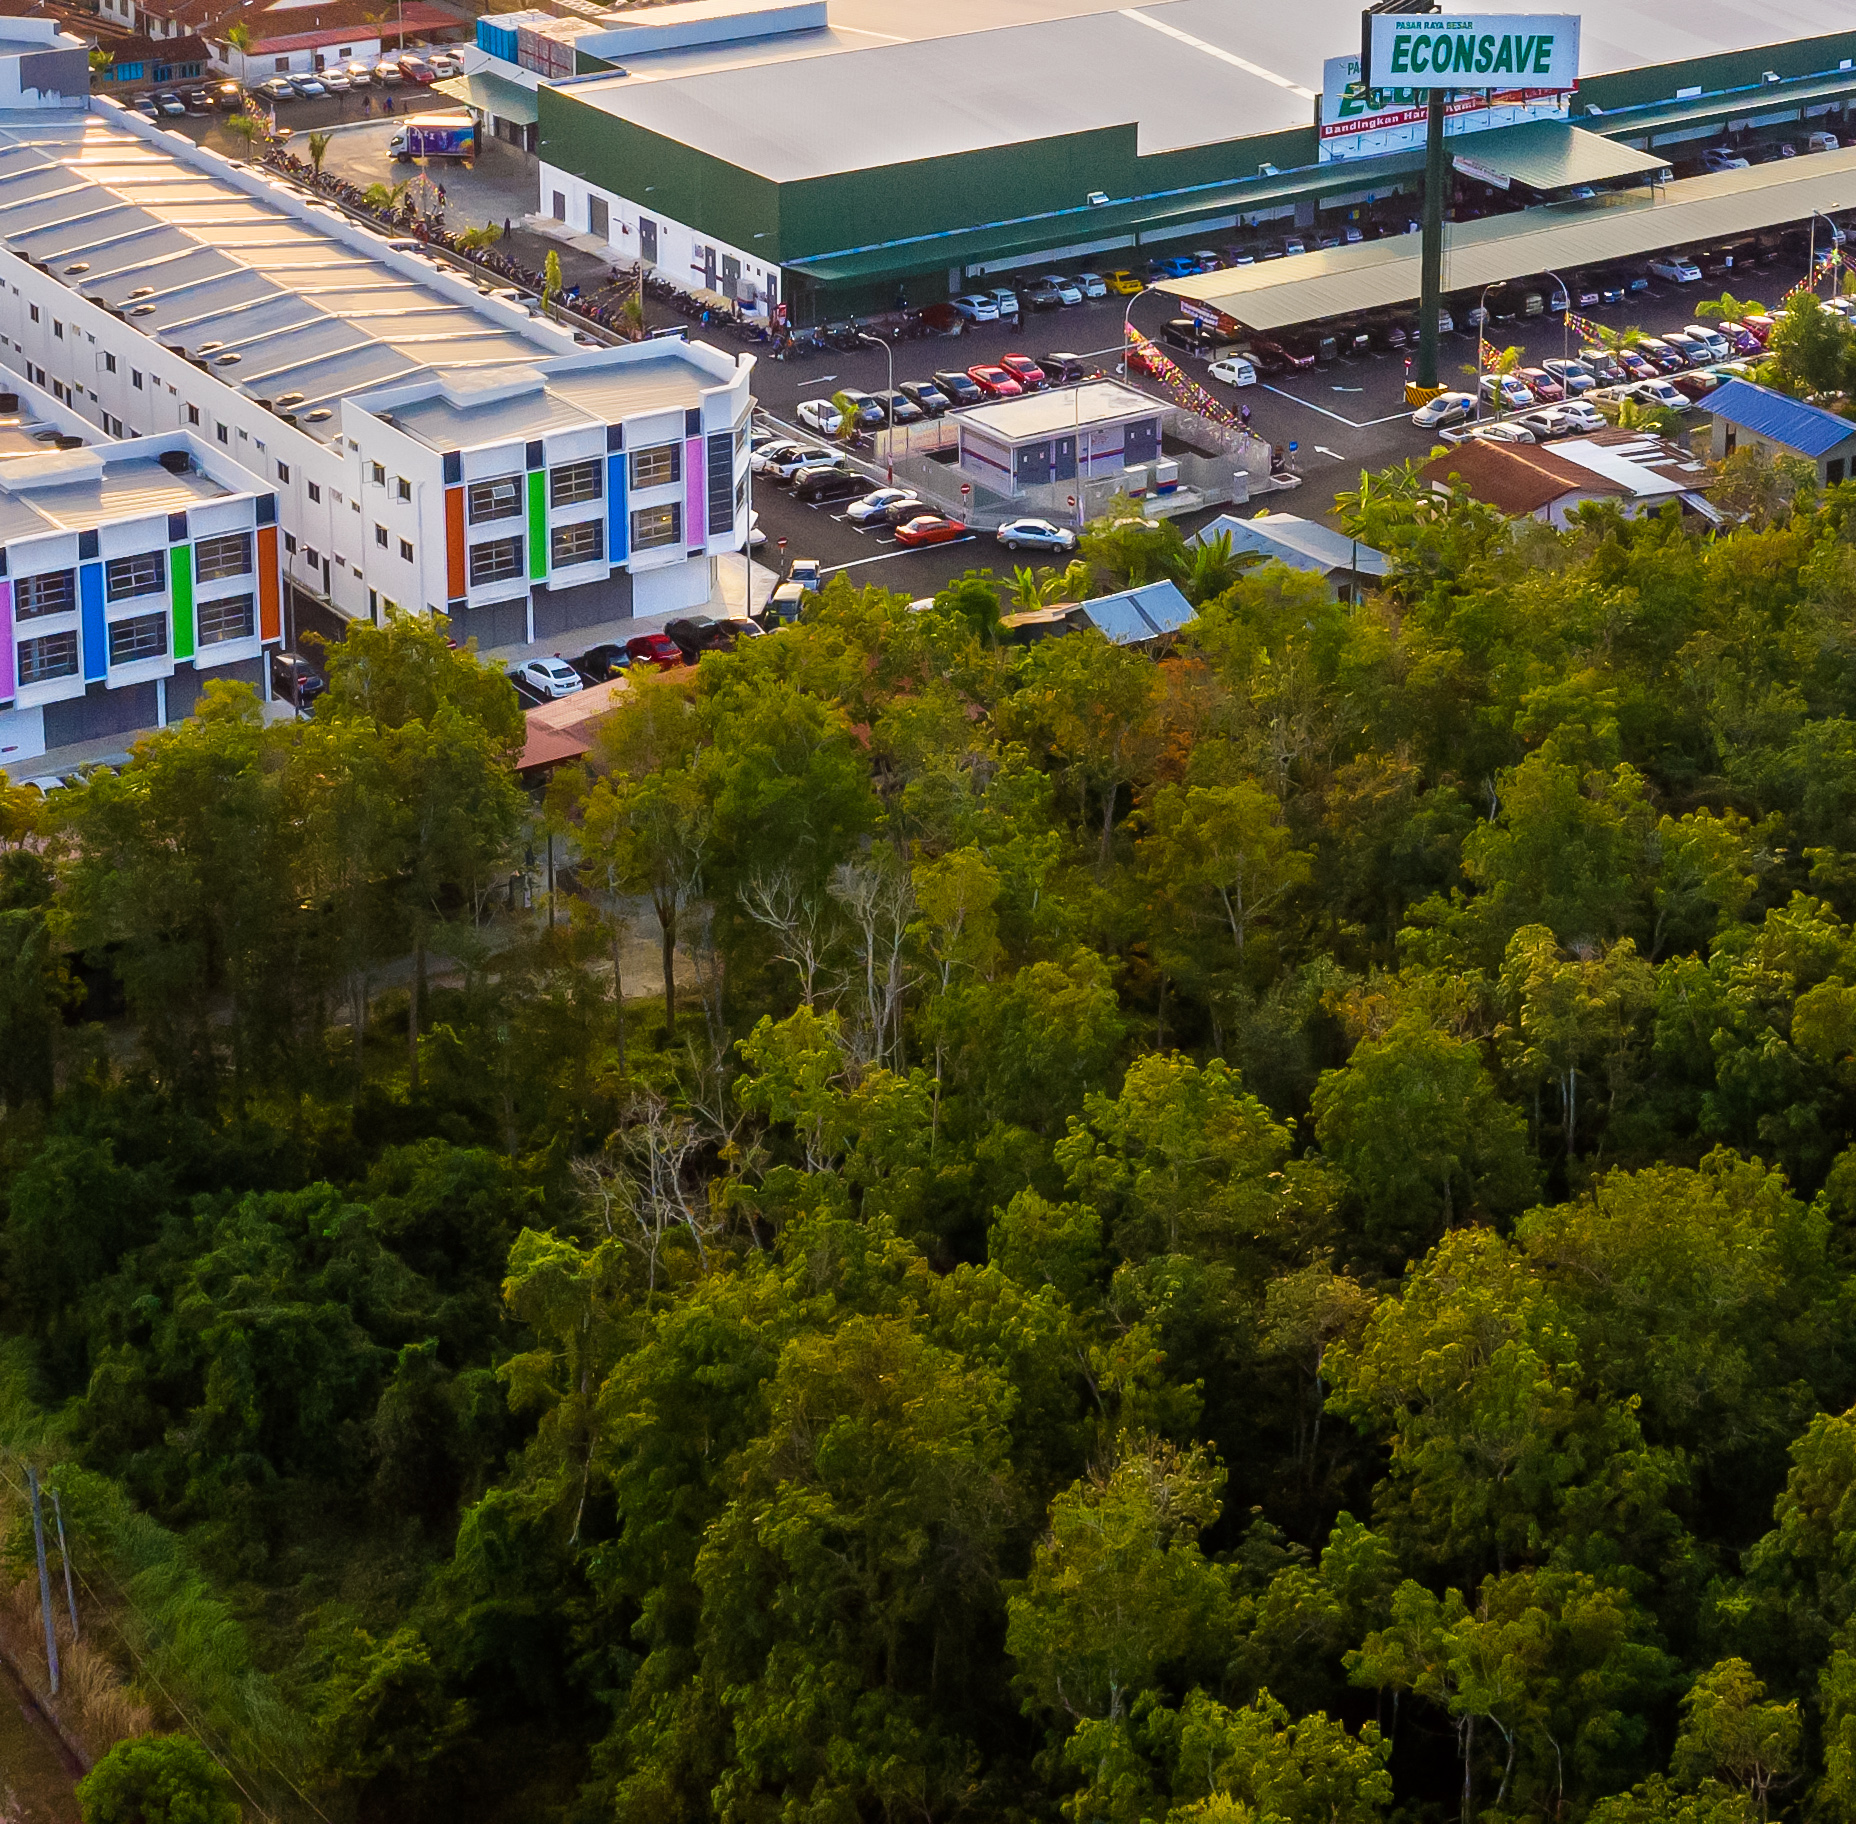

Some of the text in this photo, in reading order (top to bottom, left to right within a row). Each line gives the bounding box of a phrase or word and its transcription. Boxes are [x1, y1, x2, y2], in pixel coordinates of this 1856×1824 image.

[1396, 21, 1473, 30] PASAR RAYA BESAR
[1391, 34, 1554, 74] ECONSAVE
[1325, 116, 1399, 135] Bandingkan
